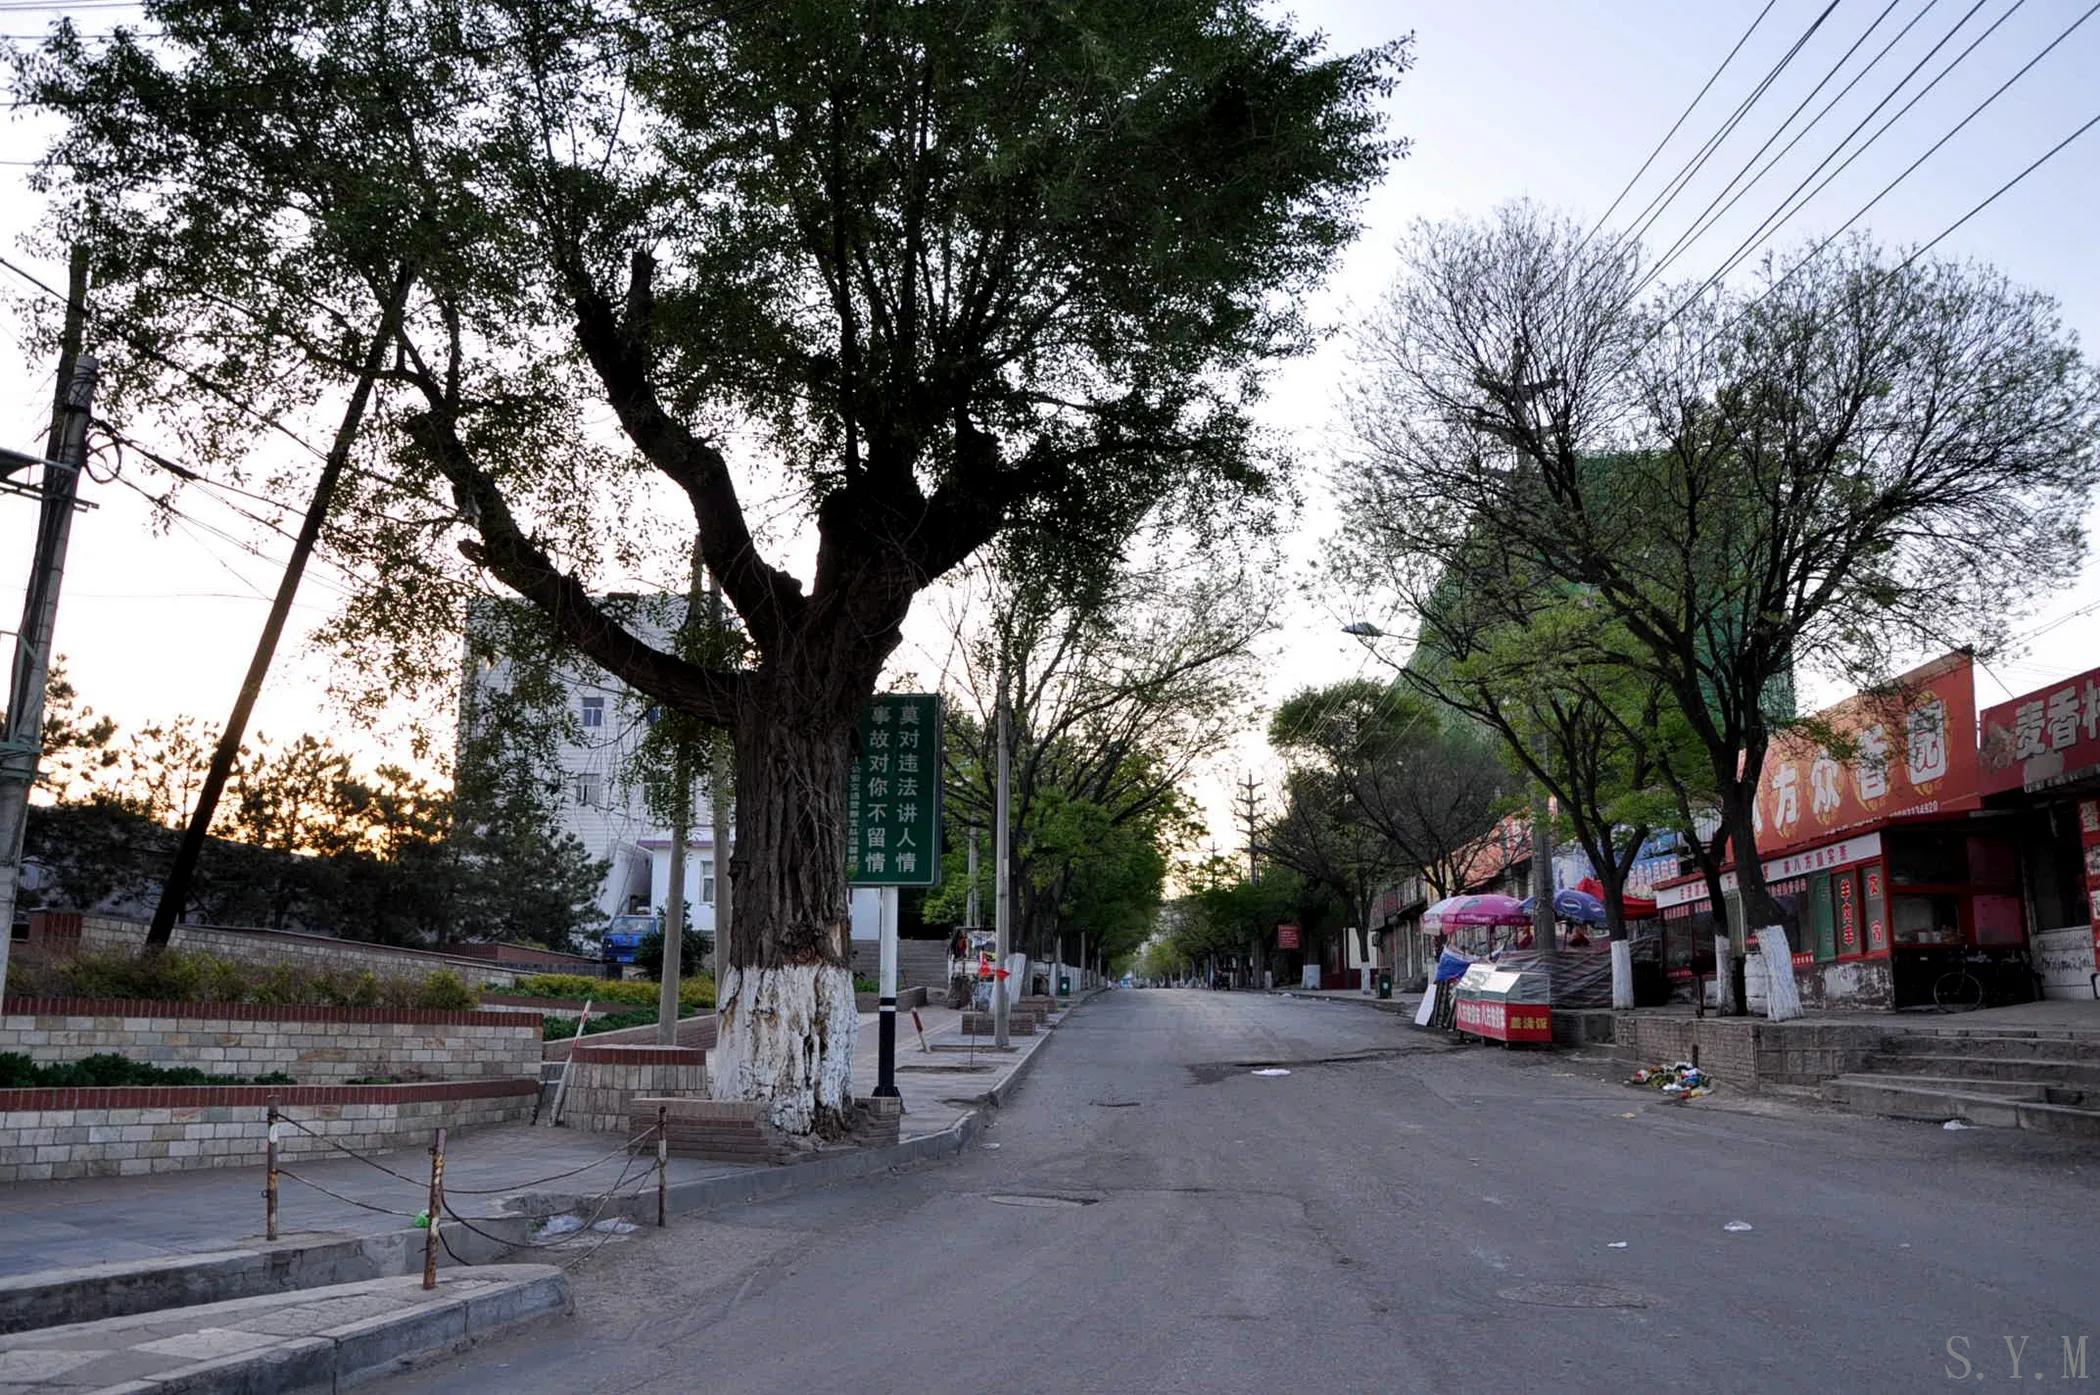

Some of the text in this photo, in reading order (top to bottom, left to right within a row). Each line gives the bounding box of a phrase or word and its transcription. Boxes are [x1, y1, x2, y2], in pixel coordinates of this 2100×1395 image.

[865, 704, 892, 875] 事故对你不留情
[895, 704, 921, 874] 莫对违法讲人情
